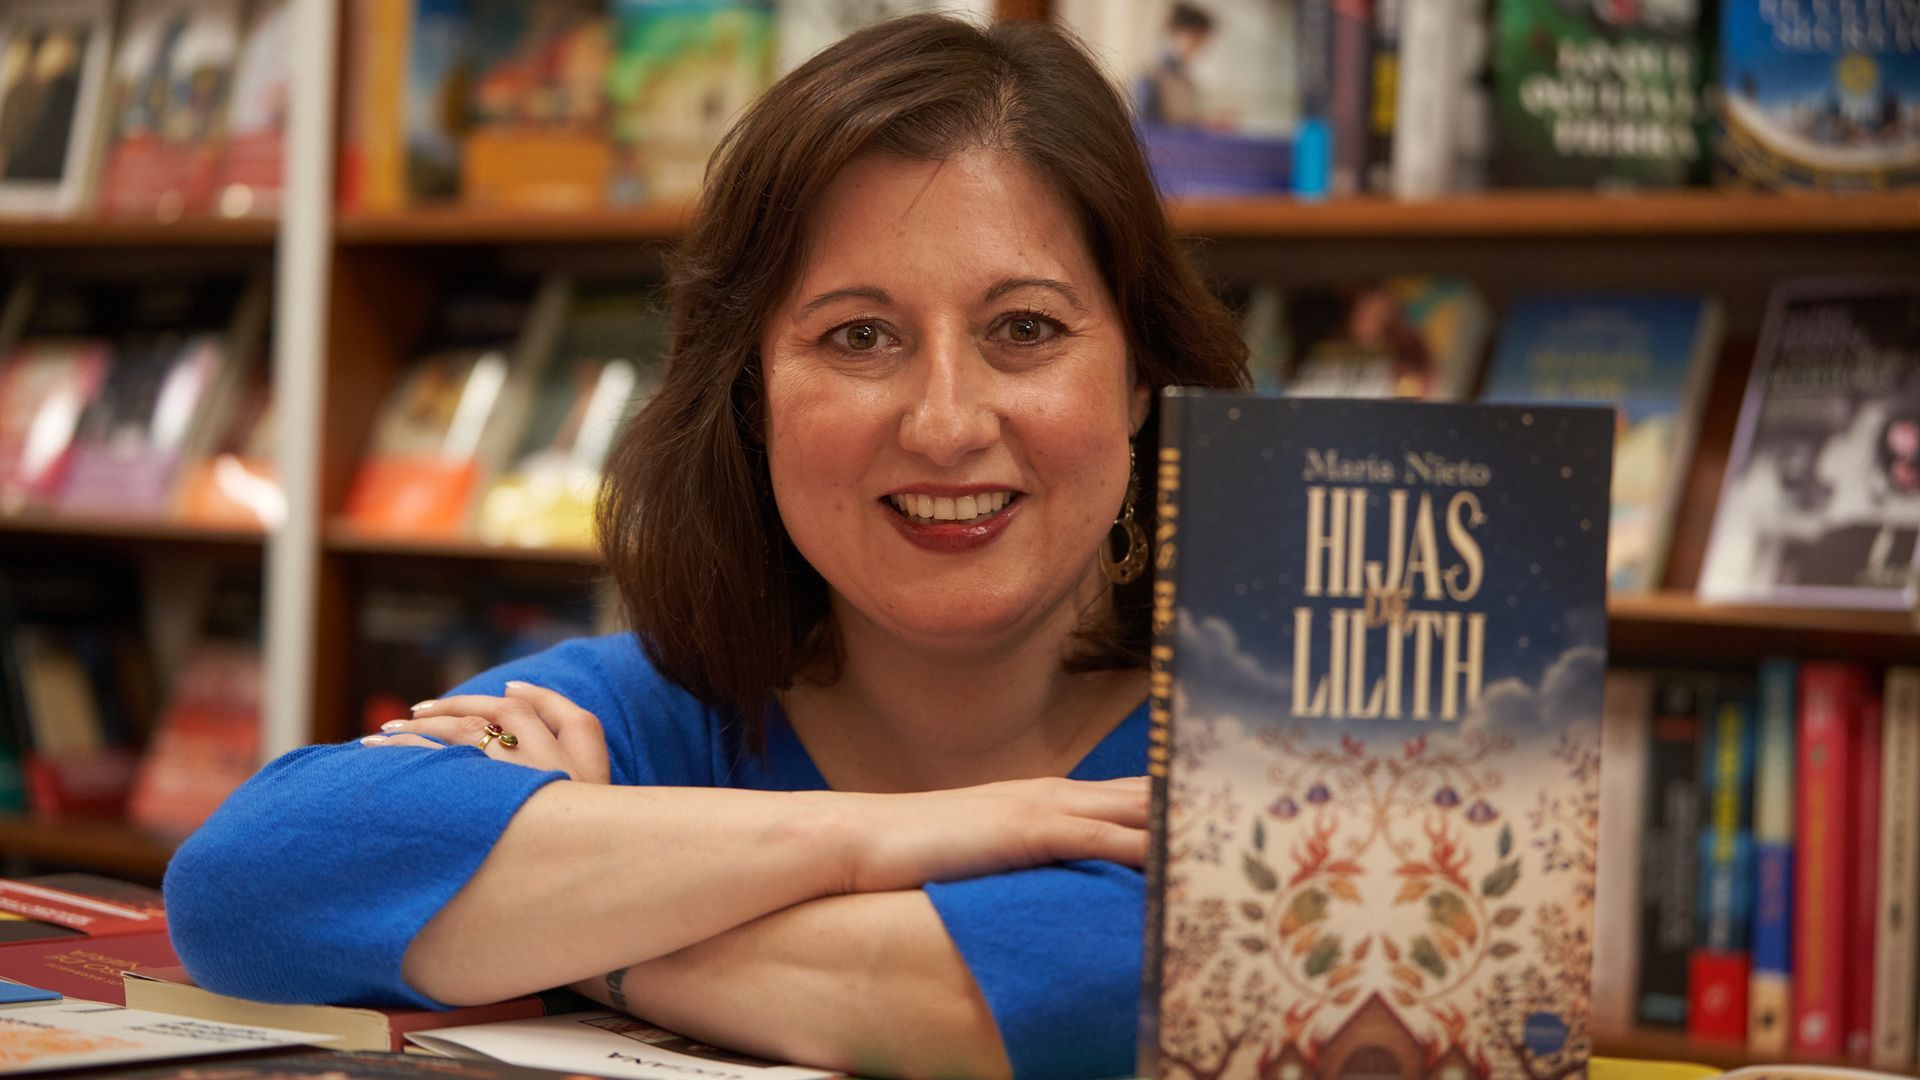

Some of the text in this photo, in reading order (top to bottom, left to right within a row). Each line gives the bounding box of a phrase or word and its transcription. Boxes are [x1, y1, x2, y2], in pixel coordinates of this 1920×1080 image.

[1405, 452, 1491, 488] Nieto
[1305, 486, 1488, 602] HIJAS
[1290, 607, 1486, 719] LILITH
